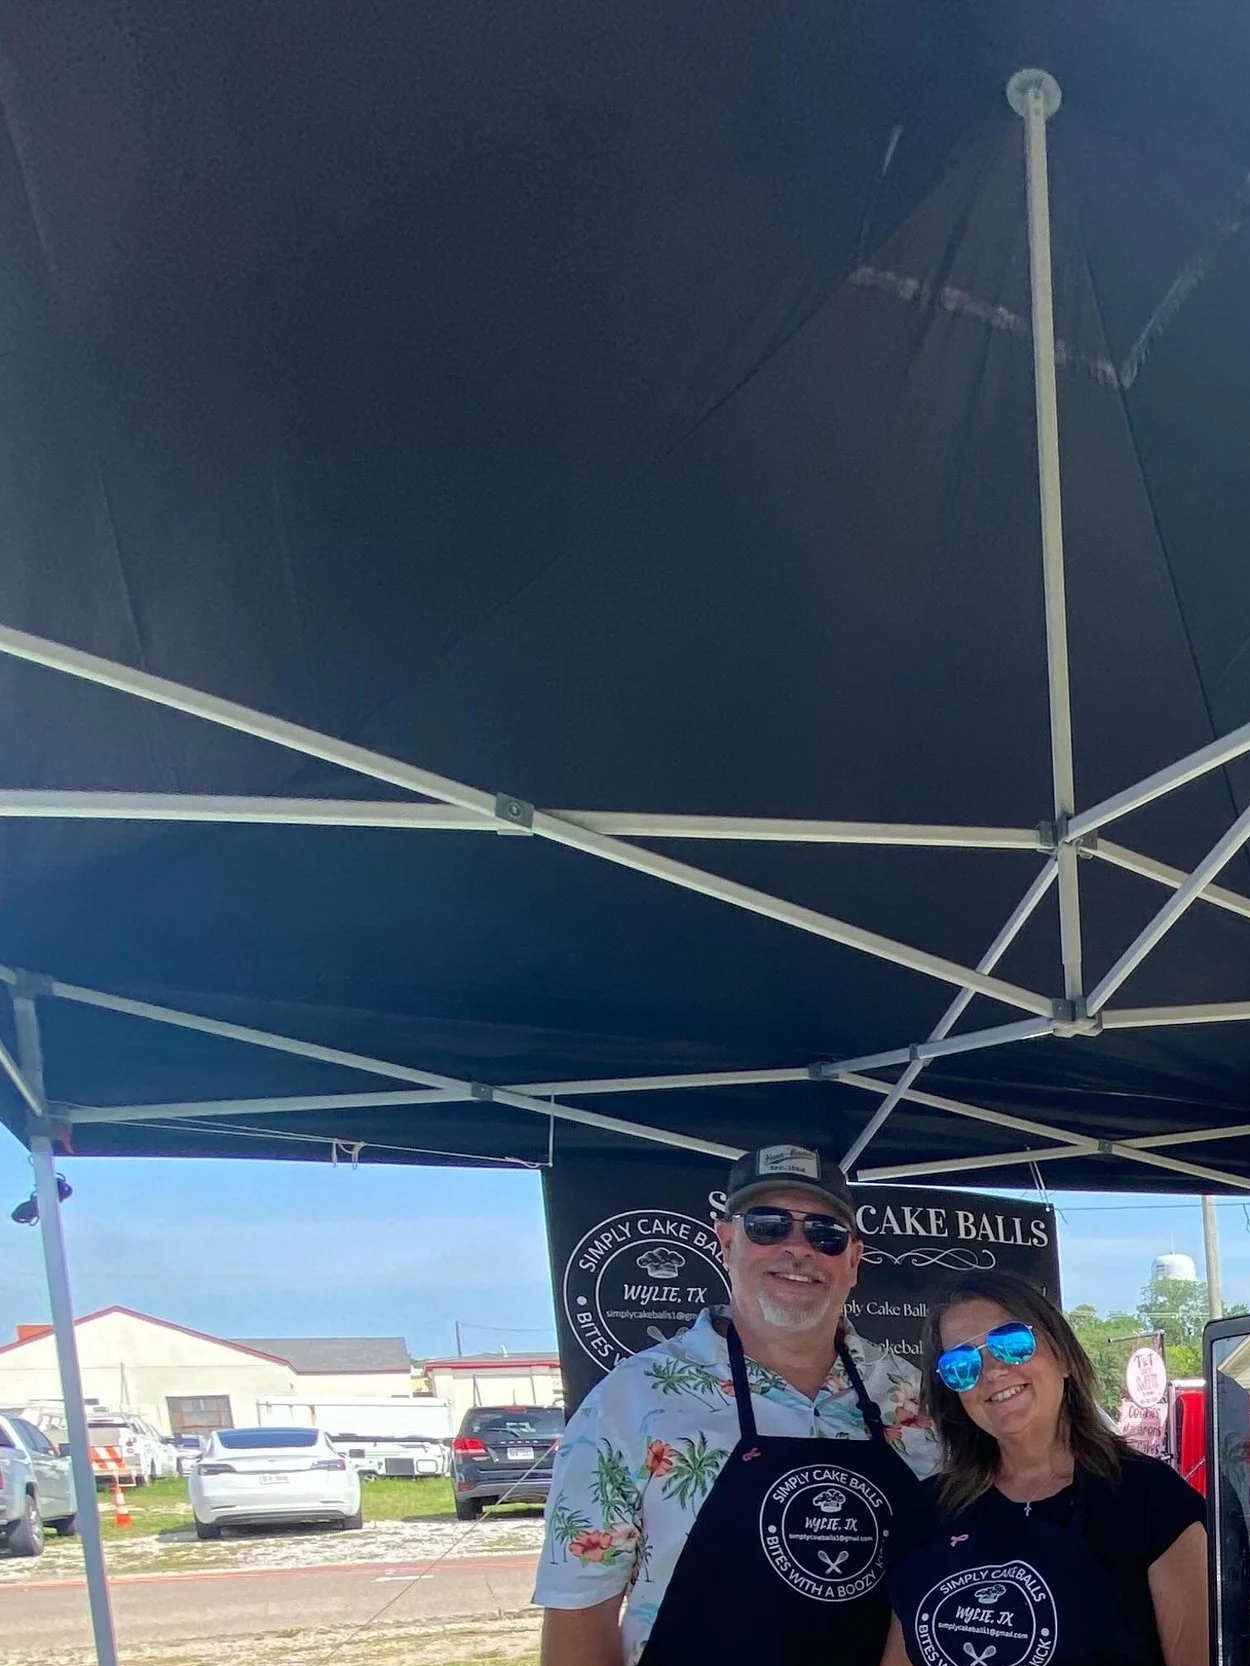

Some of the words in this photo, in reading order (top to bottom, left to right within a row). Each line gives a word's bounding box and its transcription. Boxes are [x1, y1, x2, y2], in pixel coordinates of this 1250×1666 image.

[856, 1205, 948, 1238] CAKE
[955, 1210, 1049, 1247] BALLS
[579, 1222, 632, 1273] SIMPLY
[637, 1219, 692, 1240] CAKE
[693, 1231, 729, 1272] BAL
[623, 1284, 682, 1305] WYLIE,
[686, 1287, 708, 1303] TX
[867, 1301, 901, 1316] Cake
[903, 1303, 930, 1317] Ball
[576, 1311, 614, 1358] BITES
[772, 1472, 810, 1503] SIMPLY
[812, 1470, 848, 1485] CAKE
[849, 1478, 883, 1508] BALLS
[844, 1518, 858, 1531] TX
[766, 1536, 791, 1572] BITES
[789, 1569, 823, 1595] WITH
[824, 1586, 834, 1598] A
[837, 1569, 877, 1597] BOOZY
[940, 1570, 988, 1594] SIMPLY
[991, 1566, 1018, 1579] CAKE
[1015, 1568, 1047, 1602] BALLS
[997, 1611, 1014, 1627] TX
[918, 1624, 939, 1662] BITES
[1029, 1638, 1052, 1666] KICK
